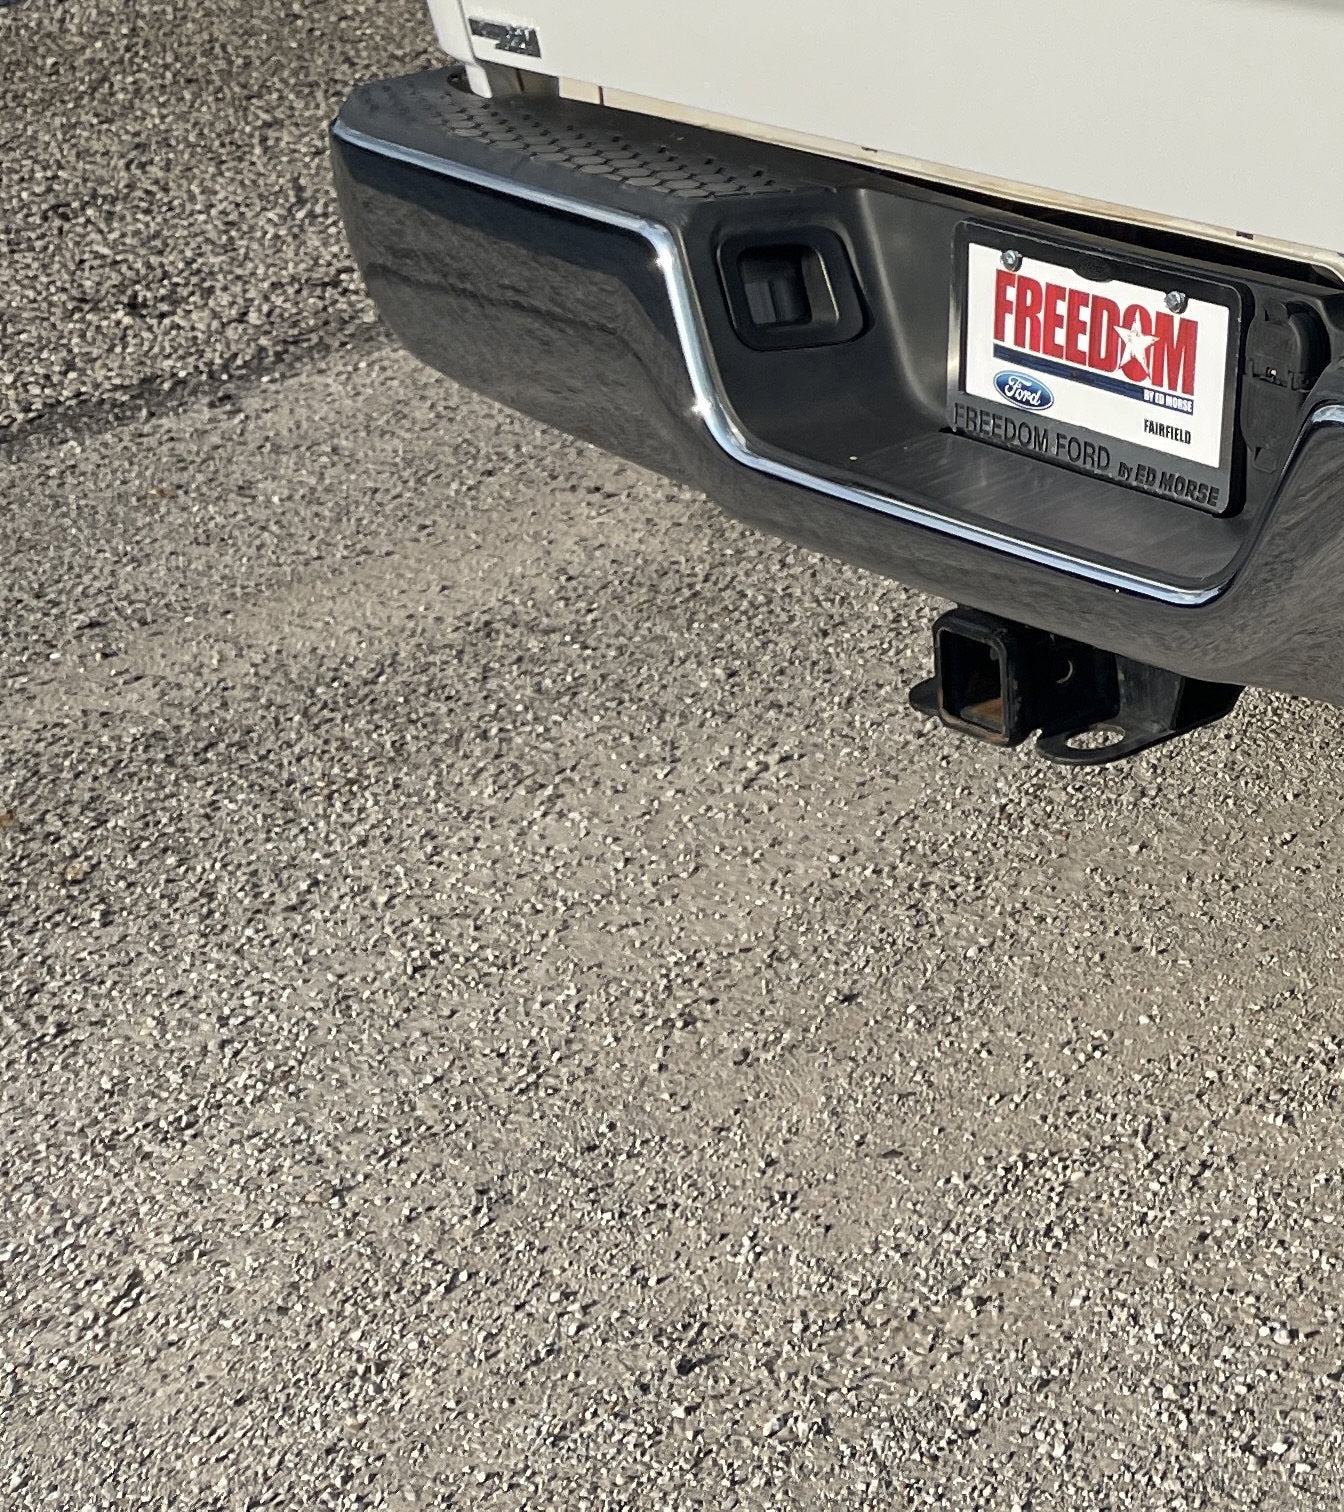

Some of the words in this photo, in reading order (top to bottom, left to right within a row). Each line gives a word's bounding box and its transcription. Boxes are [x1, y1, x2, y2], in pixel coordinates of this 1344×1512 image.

[993, 268, 1199, 396] FREEDOM
[1004, 374, 1041, 406] Ford
[1143, 388, 1155, 402] BY
[1154, 391, 1166, 405] ED
[1165, 393, 1193, 413] MORSE
[1143, 418, 1191, 445] FAIRFIELD
[953, 401, 1049, 454] FREEDOM
[1055, 432, 1111, 471] FORD
[1135, 463, 1157, 487] ED
[1158, 471, 1221, 507] MORSE
